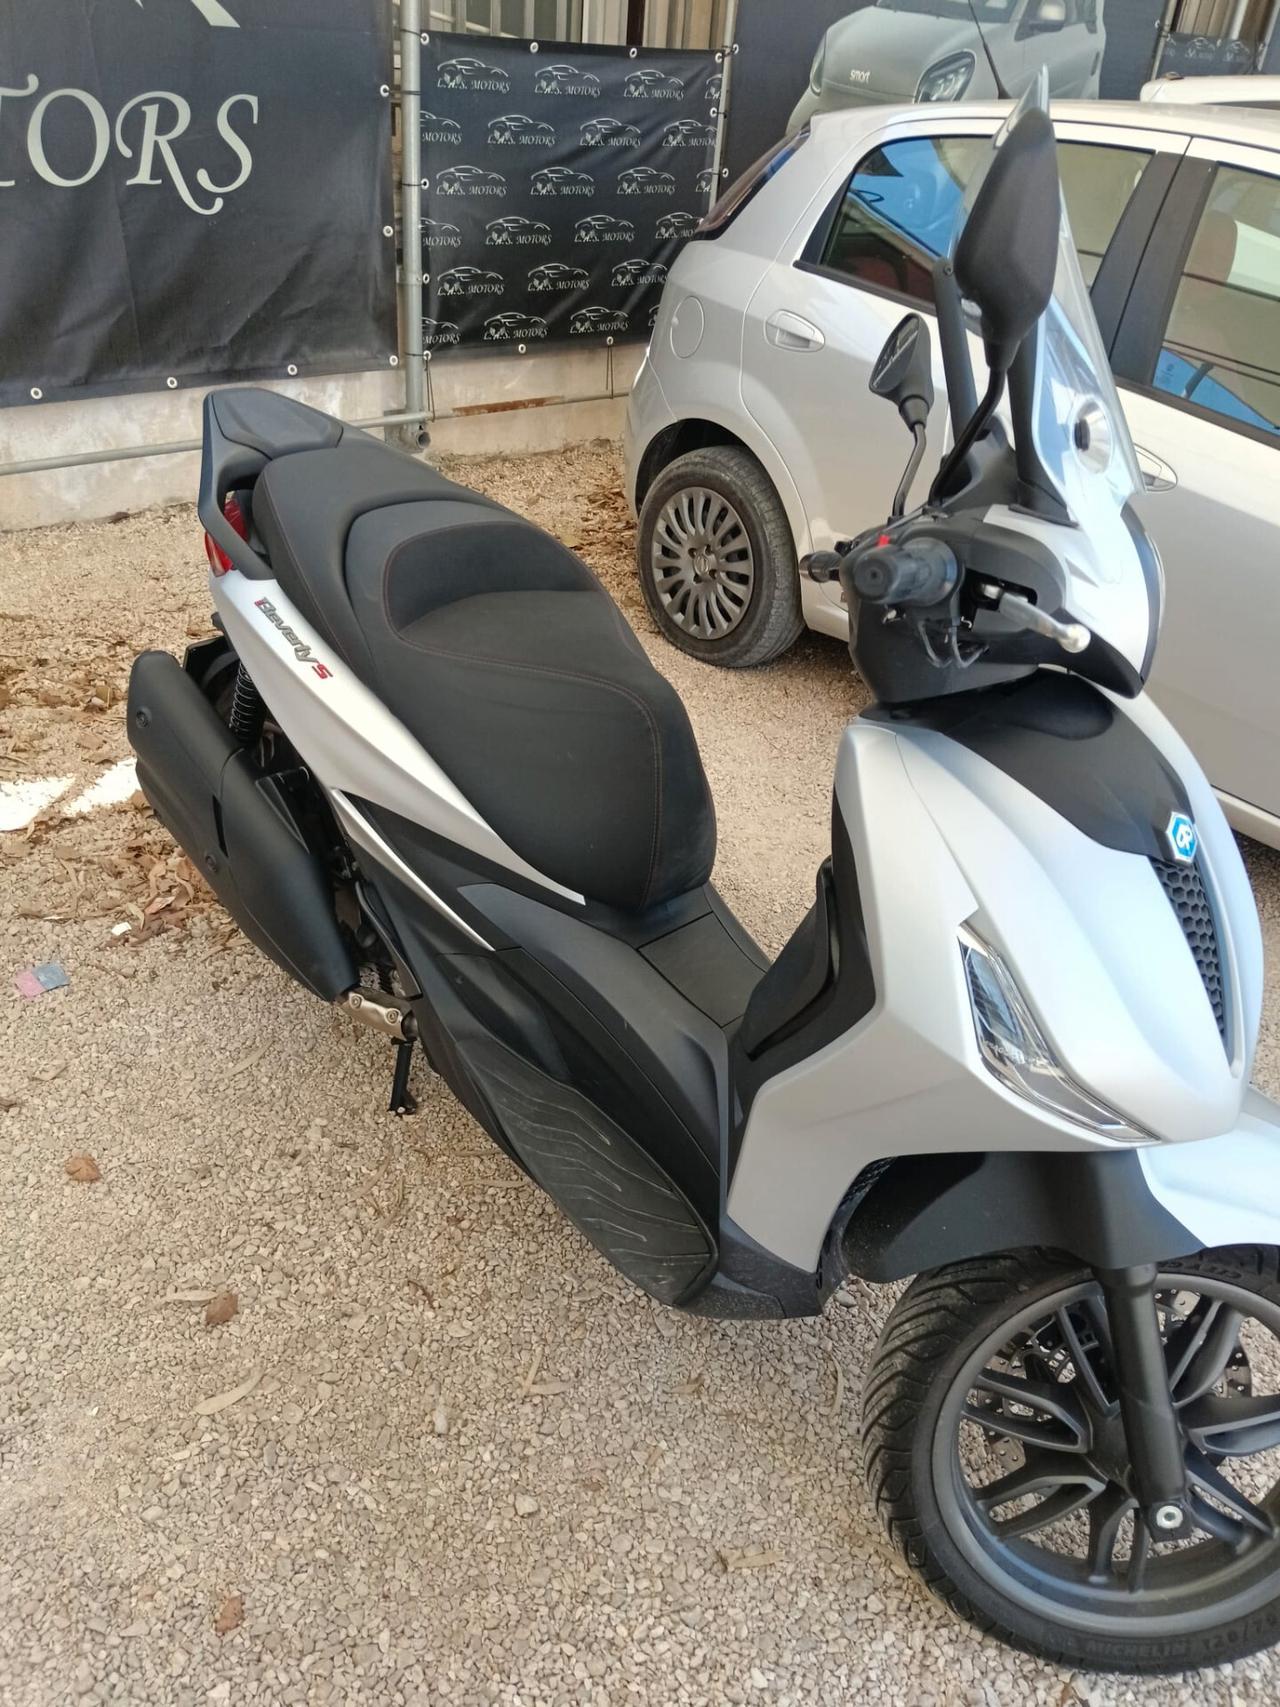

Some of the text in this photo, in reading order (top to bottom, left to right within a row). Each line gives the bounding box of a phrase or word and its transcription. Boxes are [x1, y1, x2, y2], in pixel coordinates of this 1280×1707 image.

[850, 69, 871, 83] smart
[471, 80, 511, 94] MOTORS
[565, 85, 601, 98] MOTORS
[651, 89, 684, 100] MOTORS
[422, 132, 462, 145] MOTORS
[519, 135, 556, 148] MOTORS
[608, 136, 641, 149] MOTORS
[469, 185, 508, 197] MOTORS
[560, 185, 595, 197] MOTORS
[644, 184, 676, 196] MOTORS
[423, 236, 462, 248] MOTORS
[516, 234, 553, 246] MOTORS
[602, 231, 635, 242] MOTORS
[468, 284, 505, 296] MOTORS
[556, 280, 590, 291] MOTORS
[597, 321, 629, 331] MOTORS
[513, 327, 548, 338] MOTORS
[422, 334, 461, 345] MOTORS
[254, 597, 320, 664] Beverly
